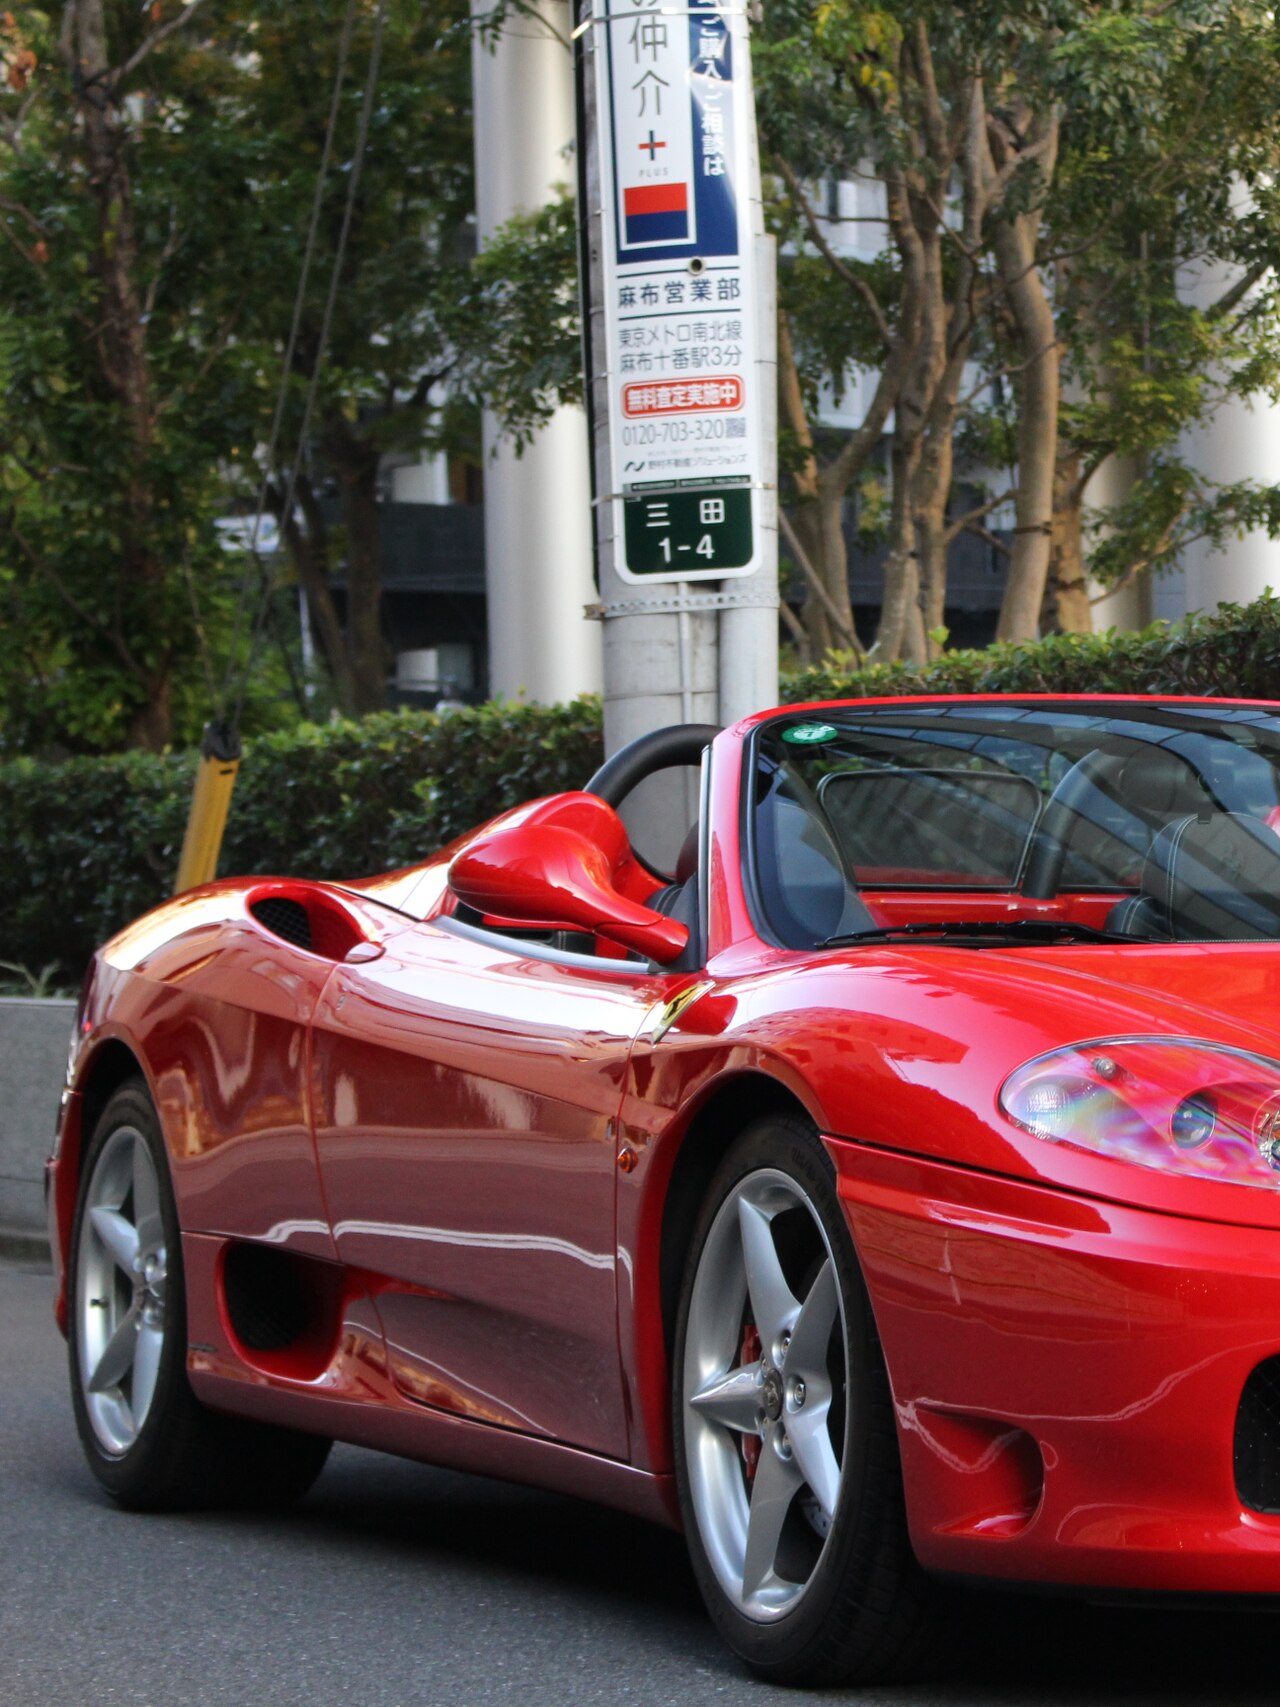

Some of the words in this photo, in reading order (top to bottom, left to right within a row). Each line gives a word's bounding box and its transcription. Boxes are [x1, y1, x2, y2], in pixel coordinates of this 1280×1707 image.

[639, 168, 669, 177] PLUS
[618, 277, 741, 309] 麻布営業部
[619, 320, 743, 348] 東京メトロ南北線
[619, 345, 743, 373] 麻布十番駅3分
[628, 382, 737, 412] 無料査定実施中
[622, 419, 725, 446] 0120-703-320
[658, 534, 715, 563] 1-4
